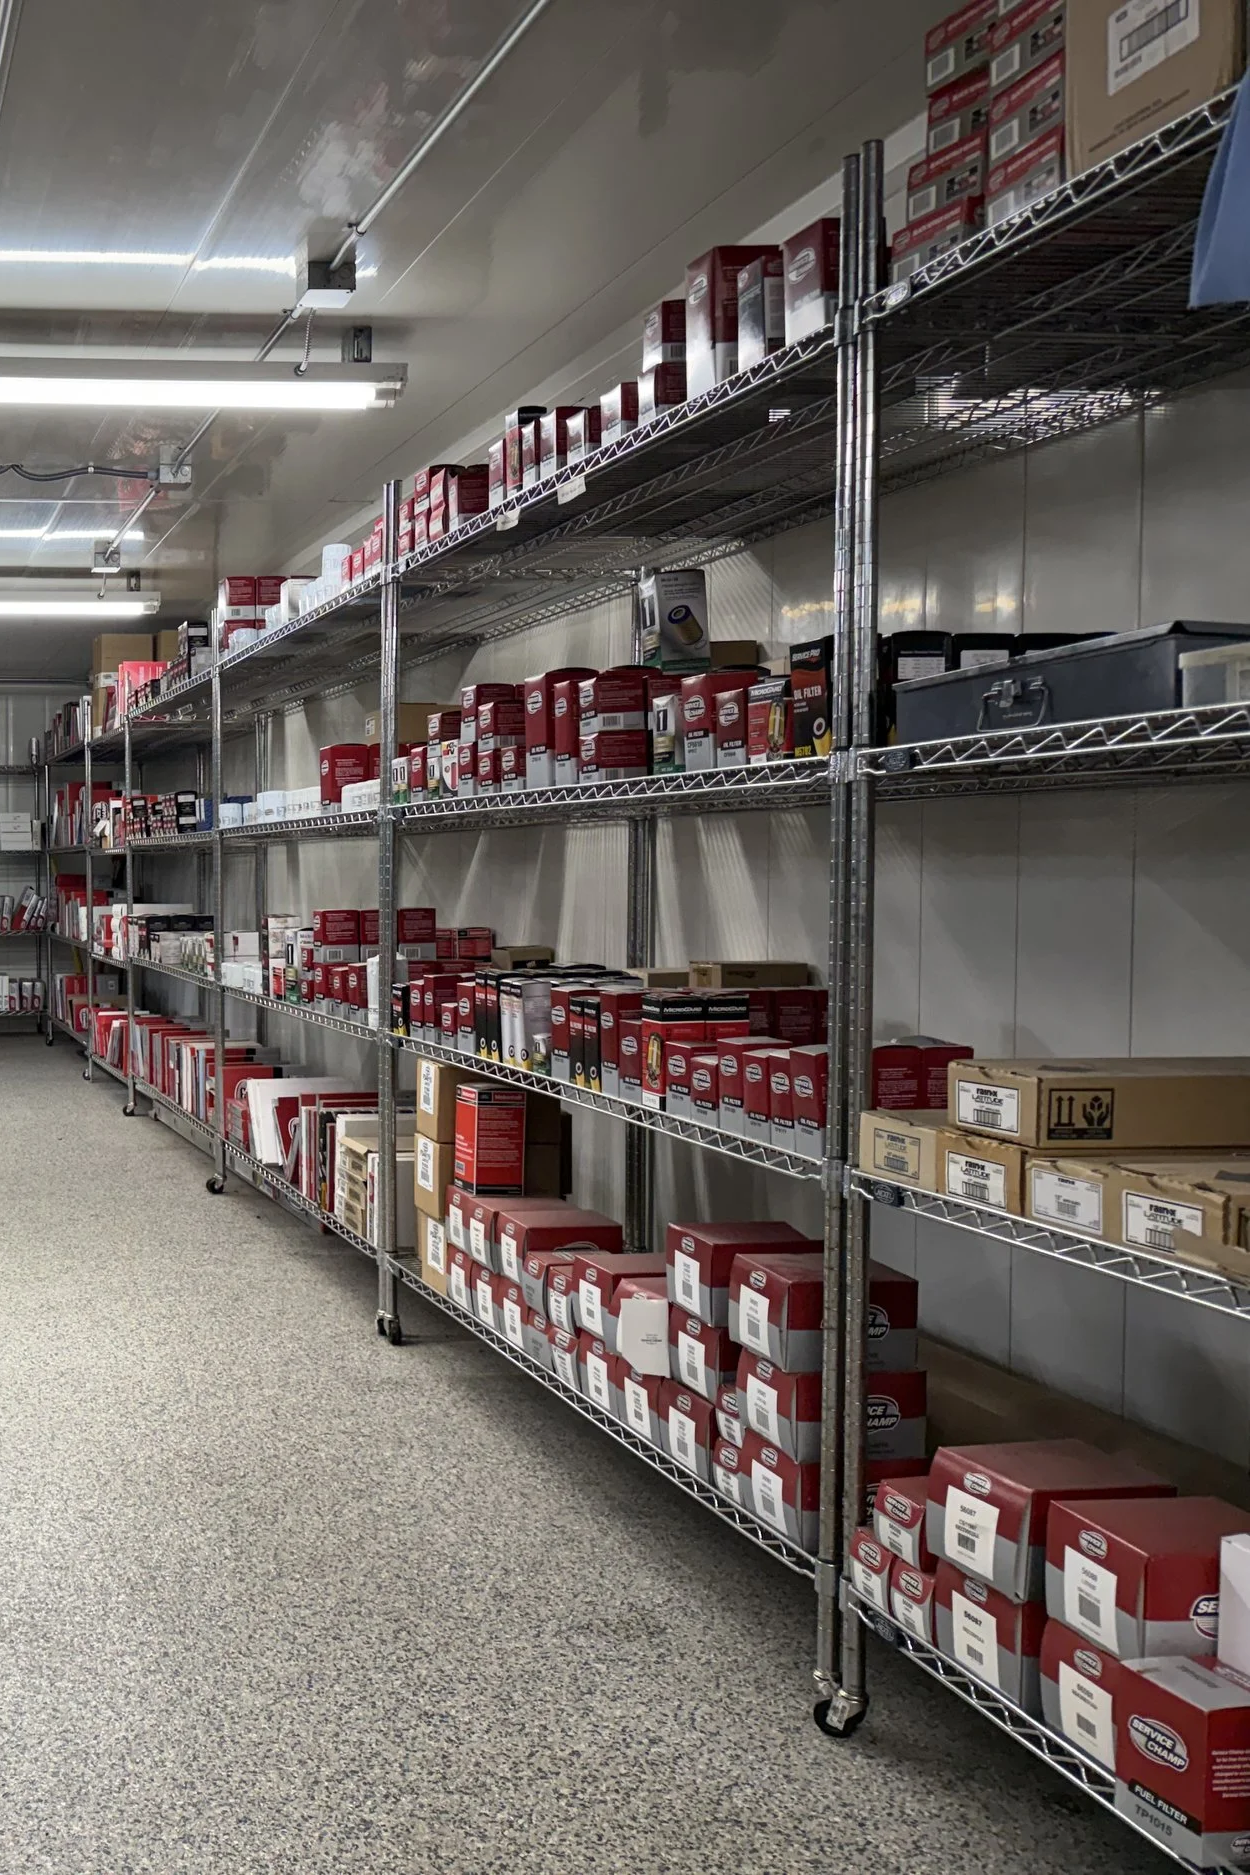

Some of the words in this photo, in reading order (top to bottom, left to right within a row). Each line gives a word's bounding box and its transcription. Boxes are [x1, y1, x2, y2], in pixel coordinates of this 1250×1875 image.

[794, 690, 802, 700] OIL
[804, 686, 822, 698] FILTER
[807, 1119, 818, 1127] FILTER
[964, 1610, 982, 1627] 56087
[1132, 1718, 1174, 1750] SERVICE
[1147, 1741, 1186, 1769] CHAMP
[1134, 1785, 1156, 1804] FUEL
[1157, 1801, 1188, 1825] FILTER
[1135, 1804, 1173, 1836] TP1015
